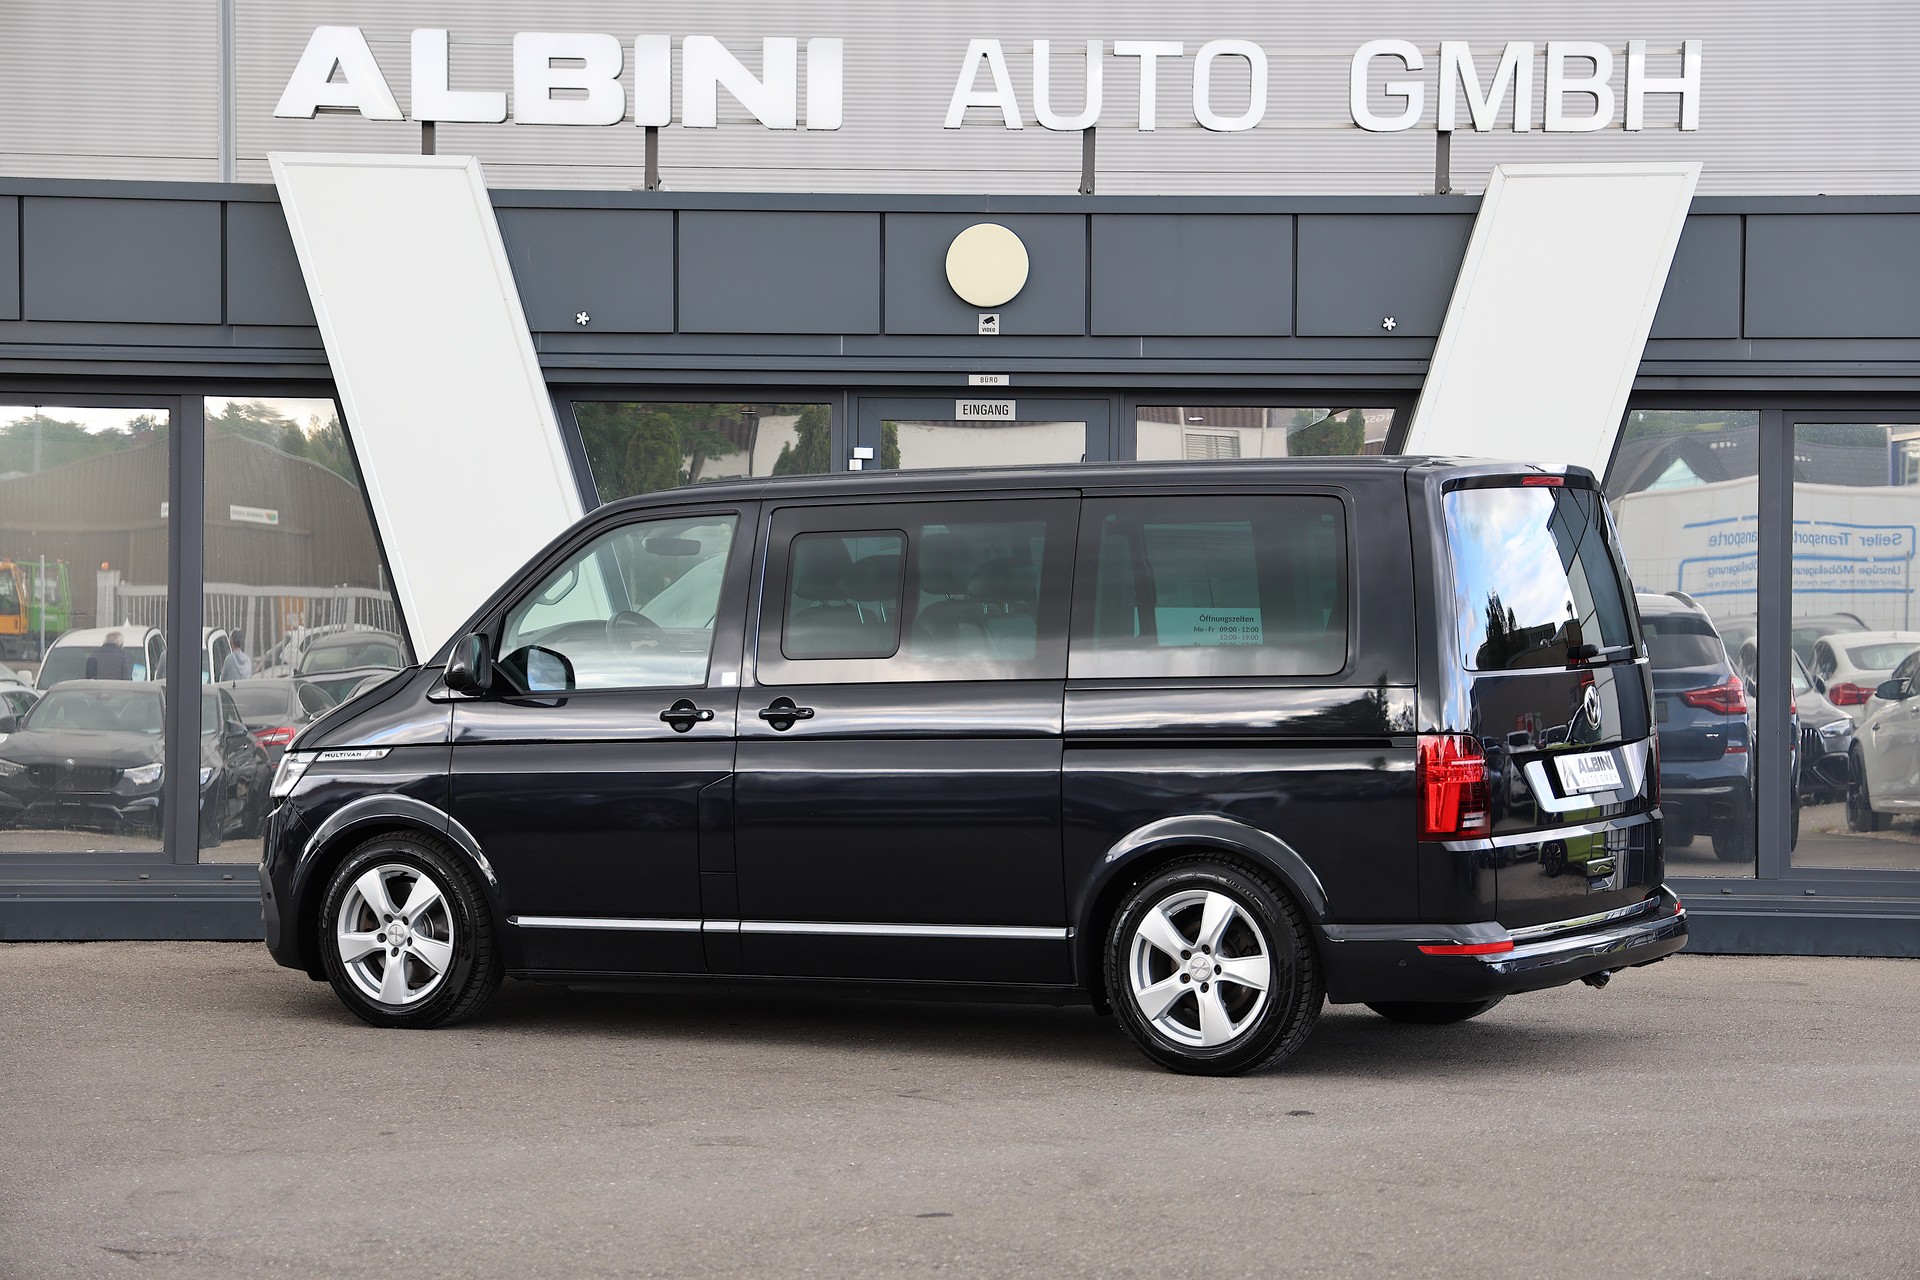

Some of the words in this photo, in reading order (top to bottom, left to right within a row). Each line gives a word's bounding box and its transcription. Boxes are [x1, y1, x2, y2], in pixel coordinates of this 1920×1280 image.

[273, 25, 844, 131] ALBINI
[944, 38, 1269, 132] AUTO
[1349, 38, 1702, 132] GMBH
[980, 376, 998, 384] BÜRO
[962, 404, 1009, 416] EINGANG
[1199, 614, 1254, 623] Öffnungszeiten
[1578, 755, 1614, 774] ALBINI
